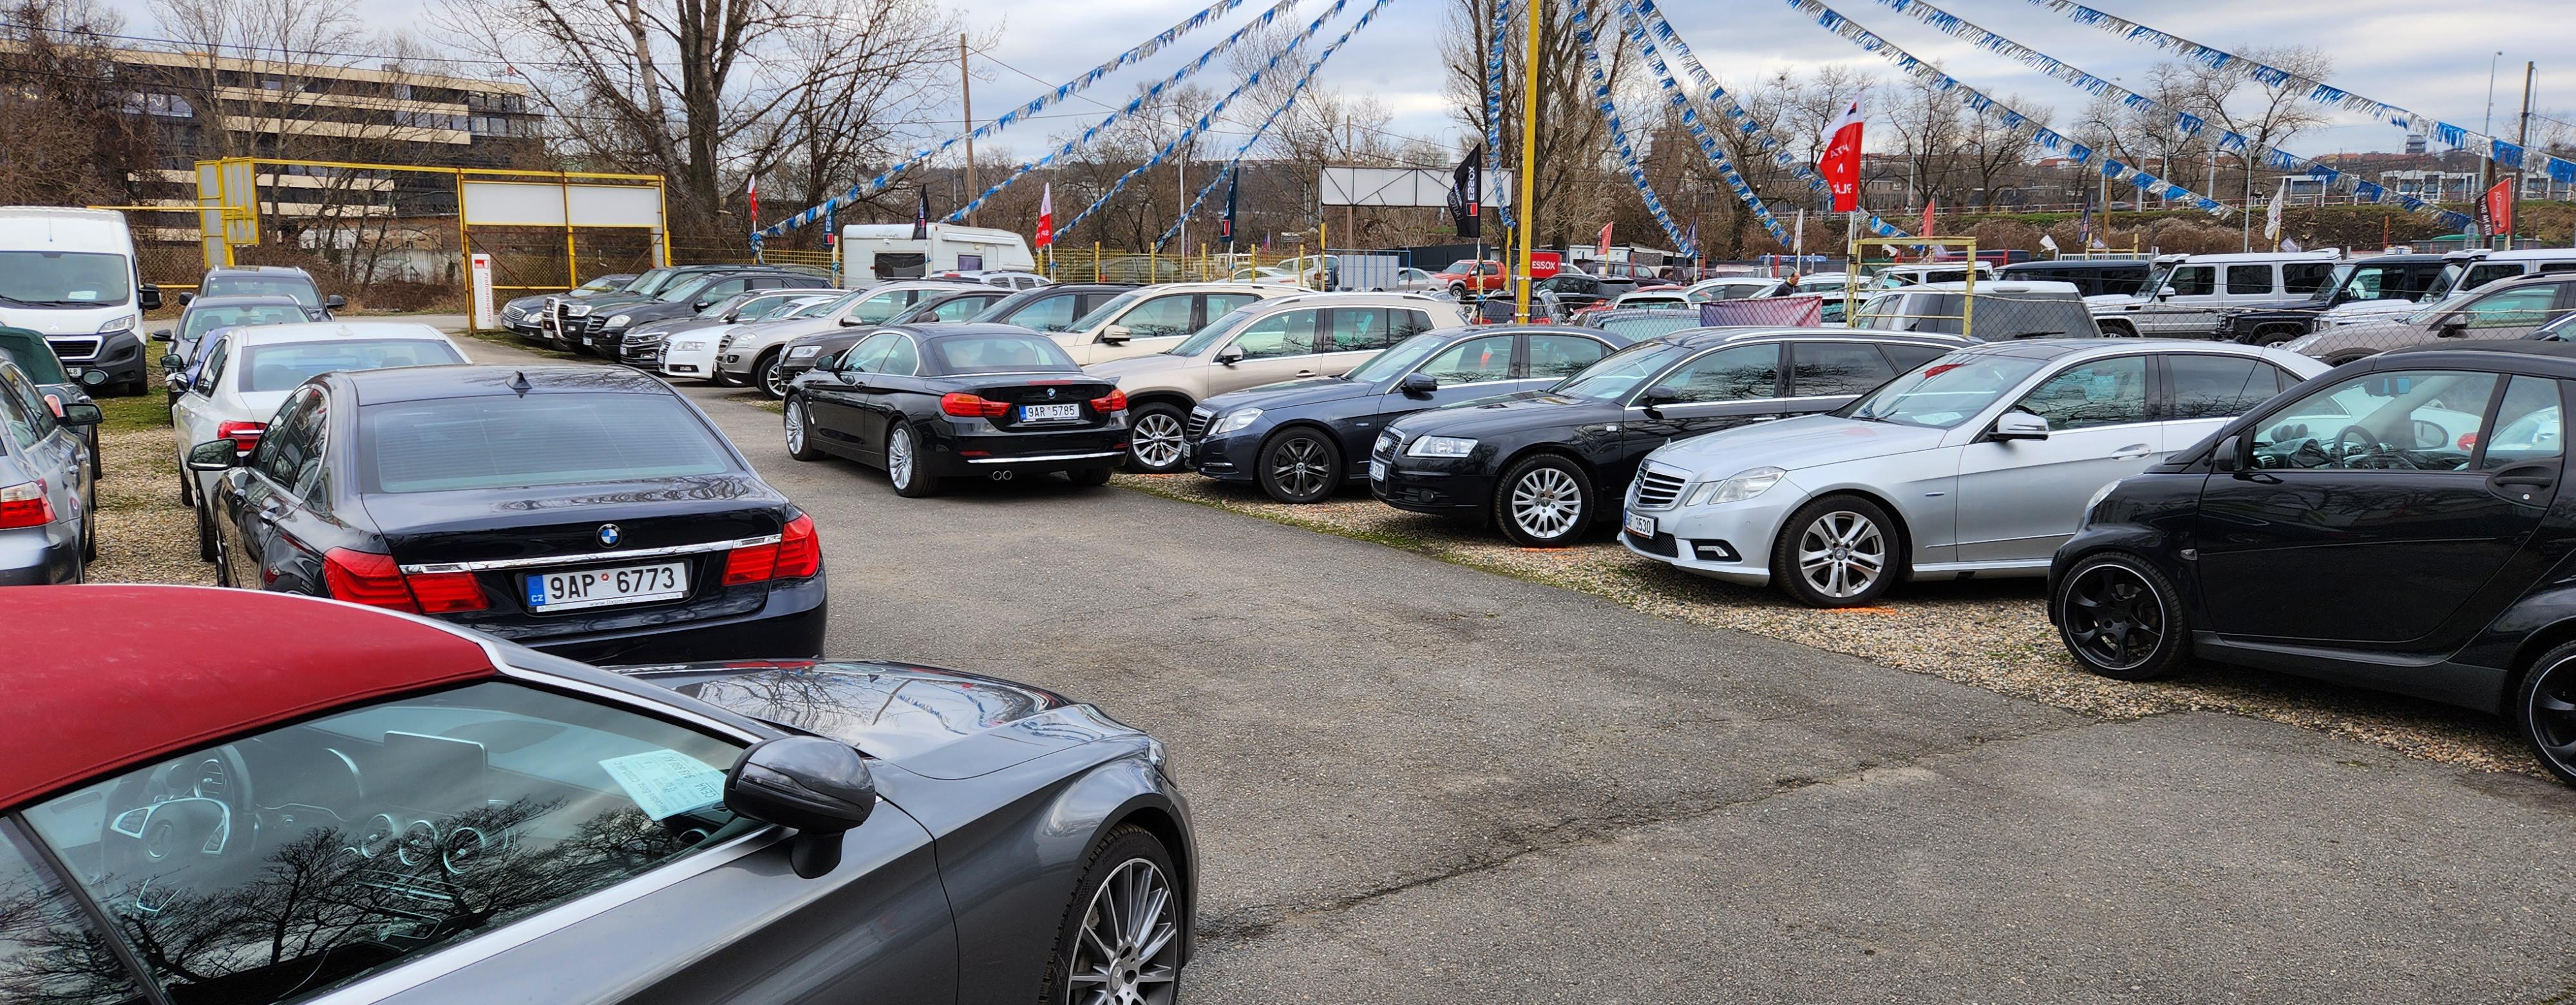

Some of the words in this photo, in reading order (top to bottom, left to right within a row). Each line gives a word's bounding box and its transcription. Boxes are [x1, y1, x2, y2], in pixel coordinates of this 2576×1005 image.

[1532, 261, 1556, 270] ESSOX
[1028, 407, 1045, 417] 9AR
[1052, 405, 1074, 416] 5785
[1636, 517, 1651, 533] 3530
[550, 574, 595, 600] 9AP
[616, 566, 675, 593] 6773
